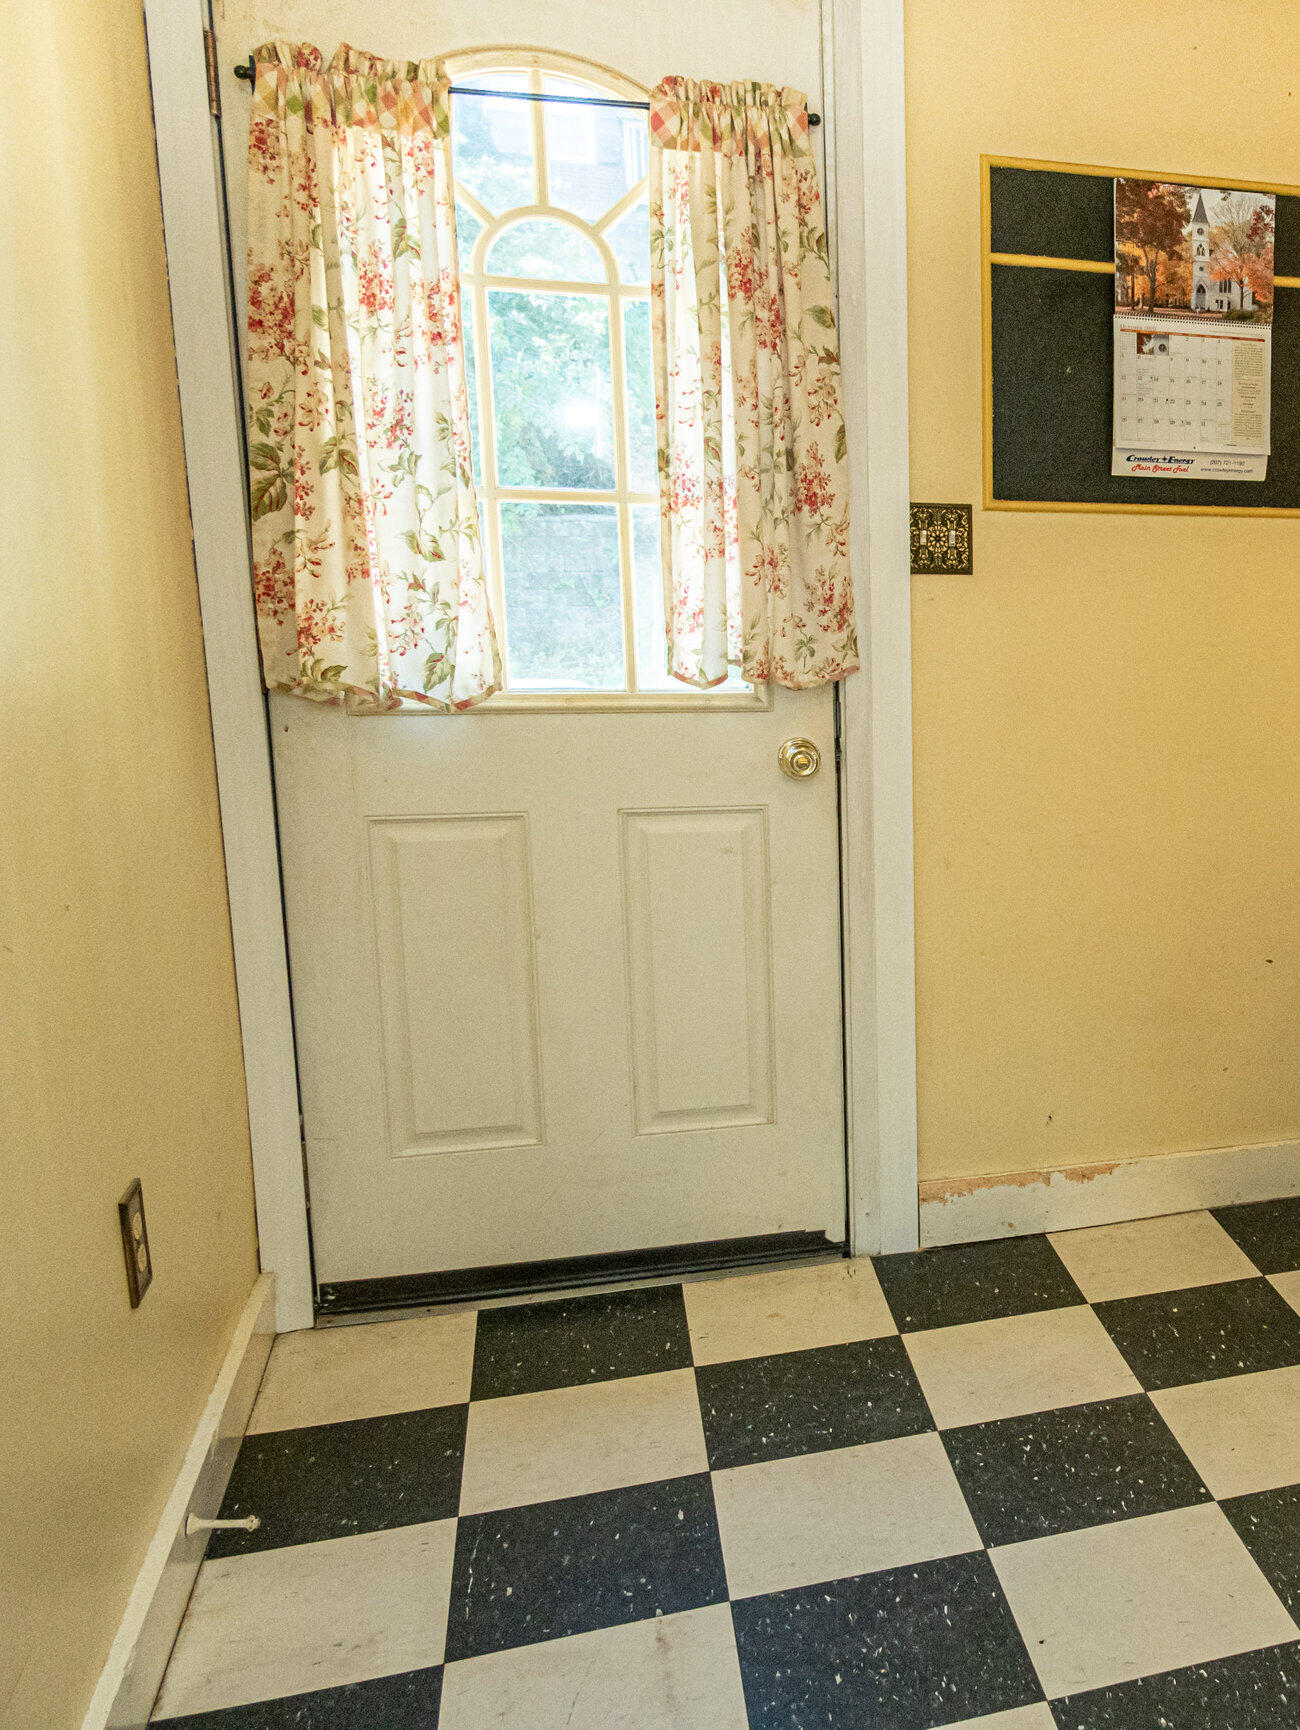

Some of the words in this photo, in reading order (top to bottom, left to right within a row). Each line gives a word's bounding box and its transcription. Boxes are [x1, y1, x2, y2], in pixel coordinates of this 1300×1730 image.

[1126, 454, 1160, 463] Crowley
[1167, 456, 1196, 465] Energy
[1131, 464, 1151, 472] Main
[1152, 464, 1173, 473] Street
[1172, 465, 1190, 474] Fuel
